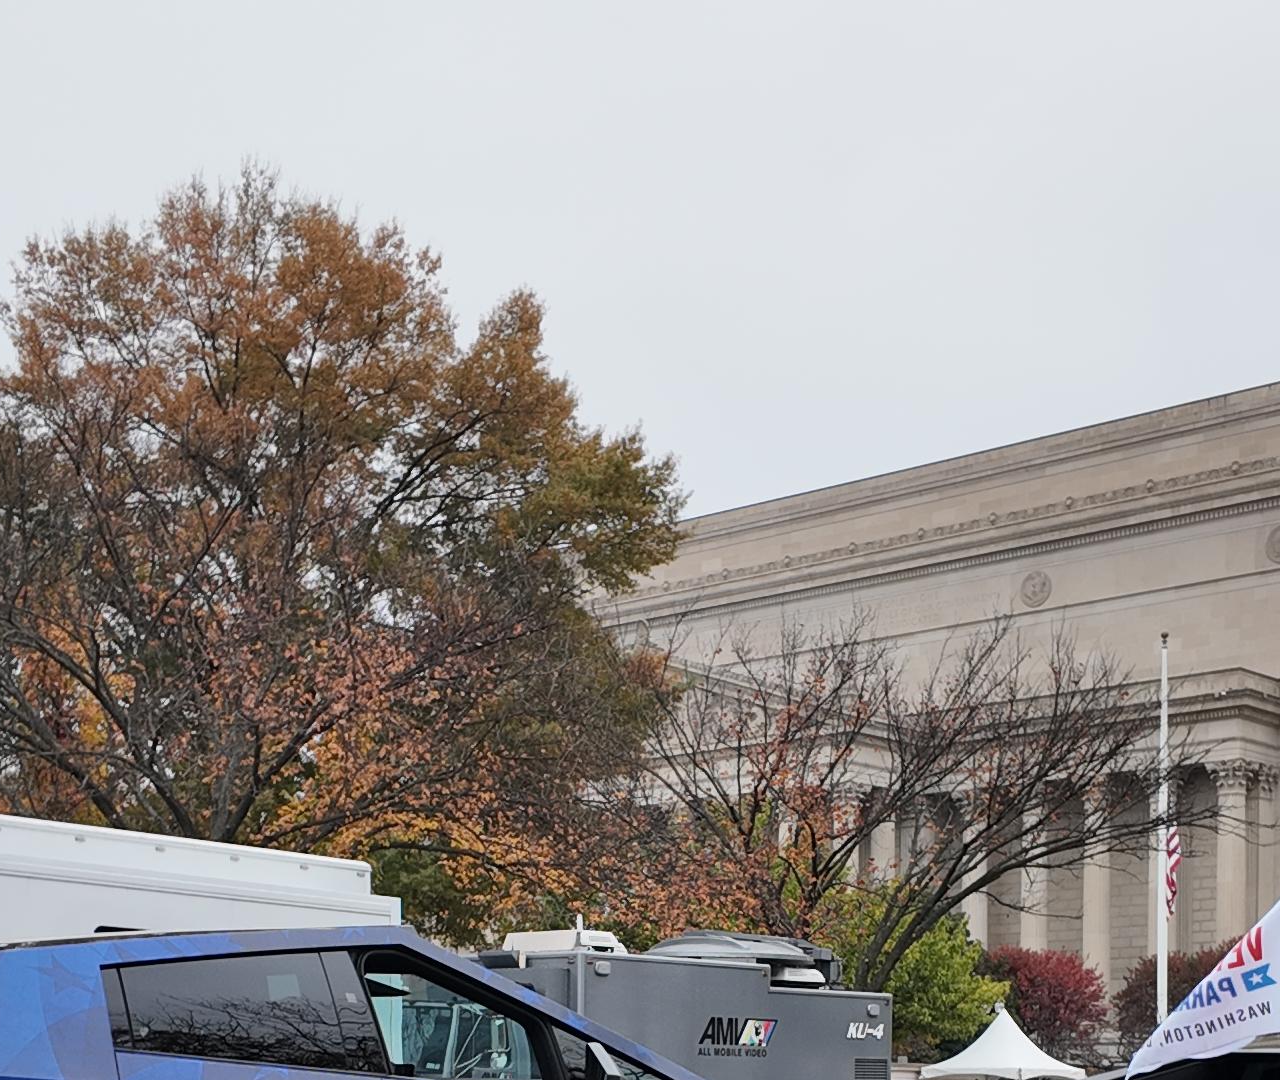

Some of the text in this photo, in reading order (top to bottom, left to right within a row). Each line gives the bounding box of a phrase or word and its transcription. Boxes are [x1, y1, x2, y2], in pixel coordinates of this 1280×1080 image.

[846, 1022, 885, 1041] KU-4
[697, 1047, 768, 1058] ALL MOBILE VIDEO
